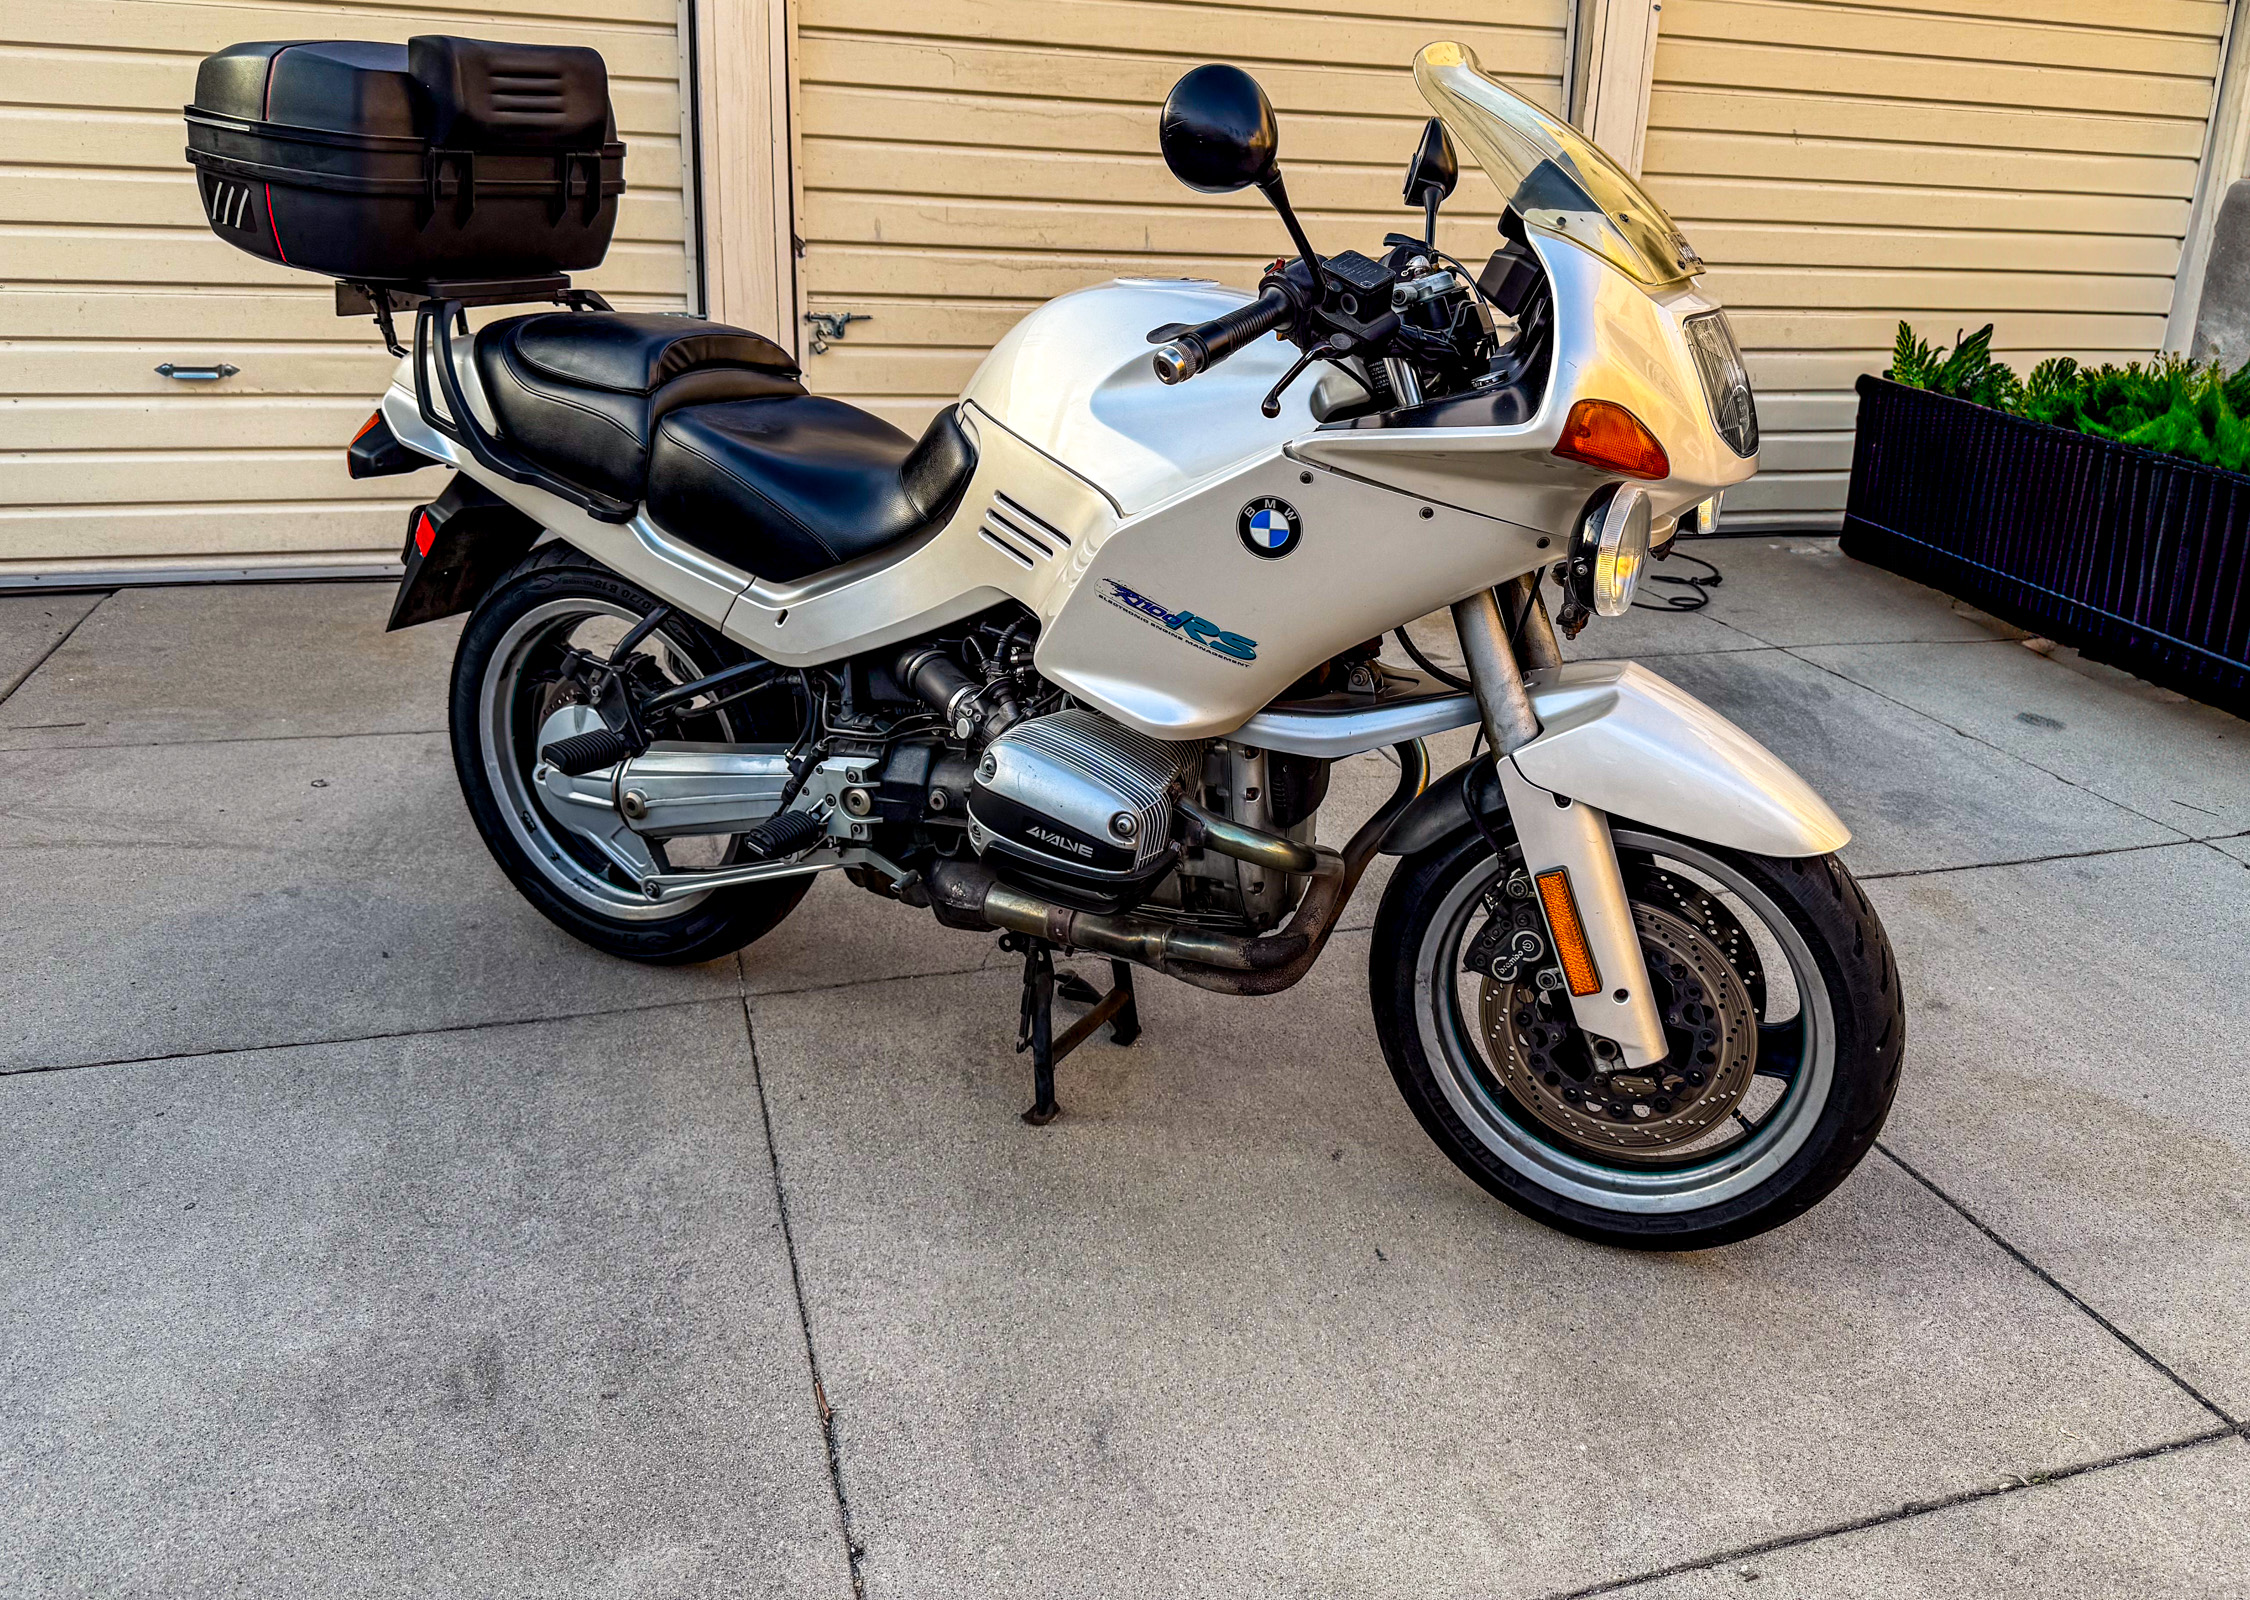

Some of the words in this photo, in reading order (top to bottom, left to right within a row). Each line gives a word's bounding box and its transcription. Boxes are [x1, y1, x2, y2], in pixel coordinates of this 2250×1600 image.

[1244, 498, 1297, 521] BMW
[1098, 593, 1150, 625] ELECTRONIC
[1150, 621, 1184, 642] ENGINE
[1184, 638, 1251, 669] MANAGEMENT
[1497, 949, 1525, 975] brembo
